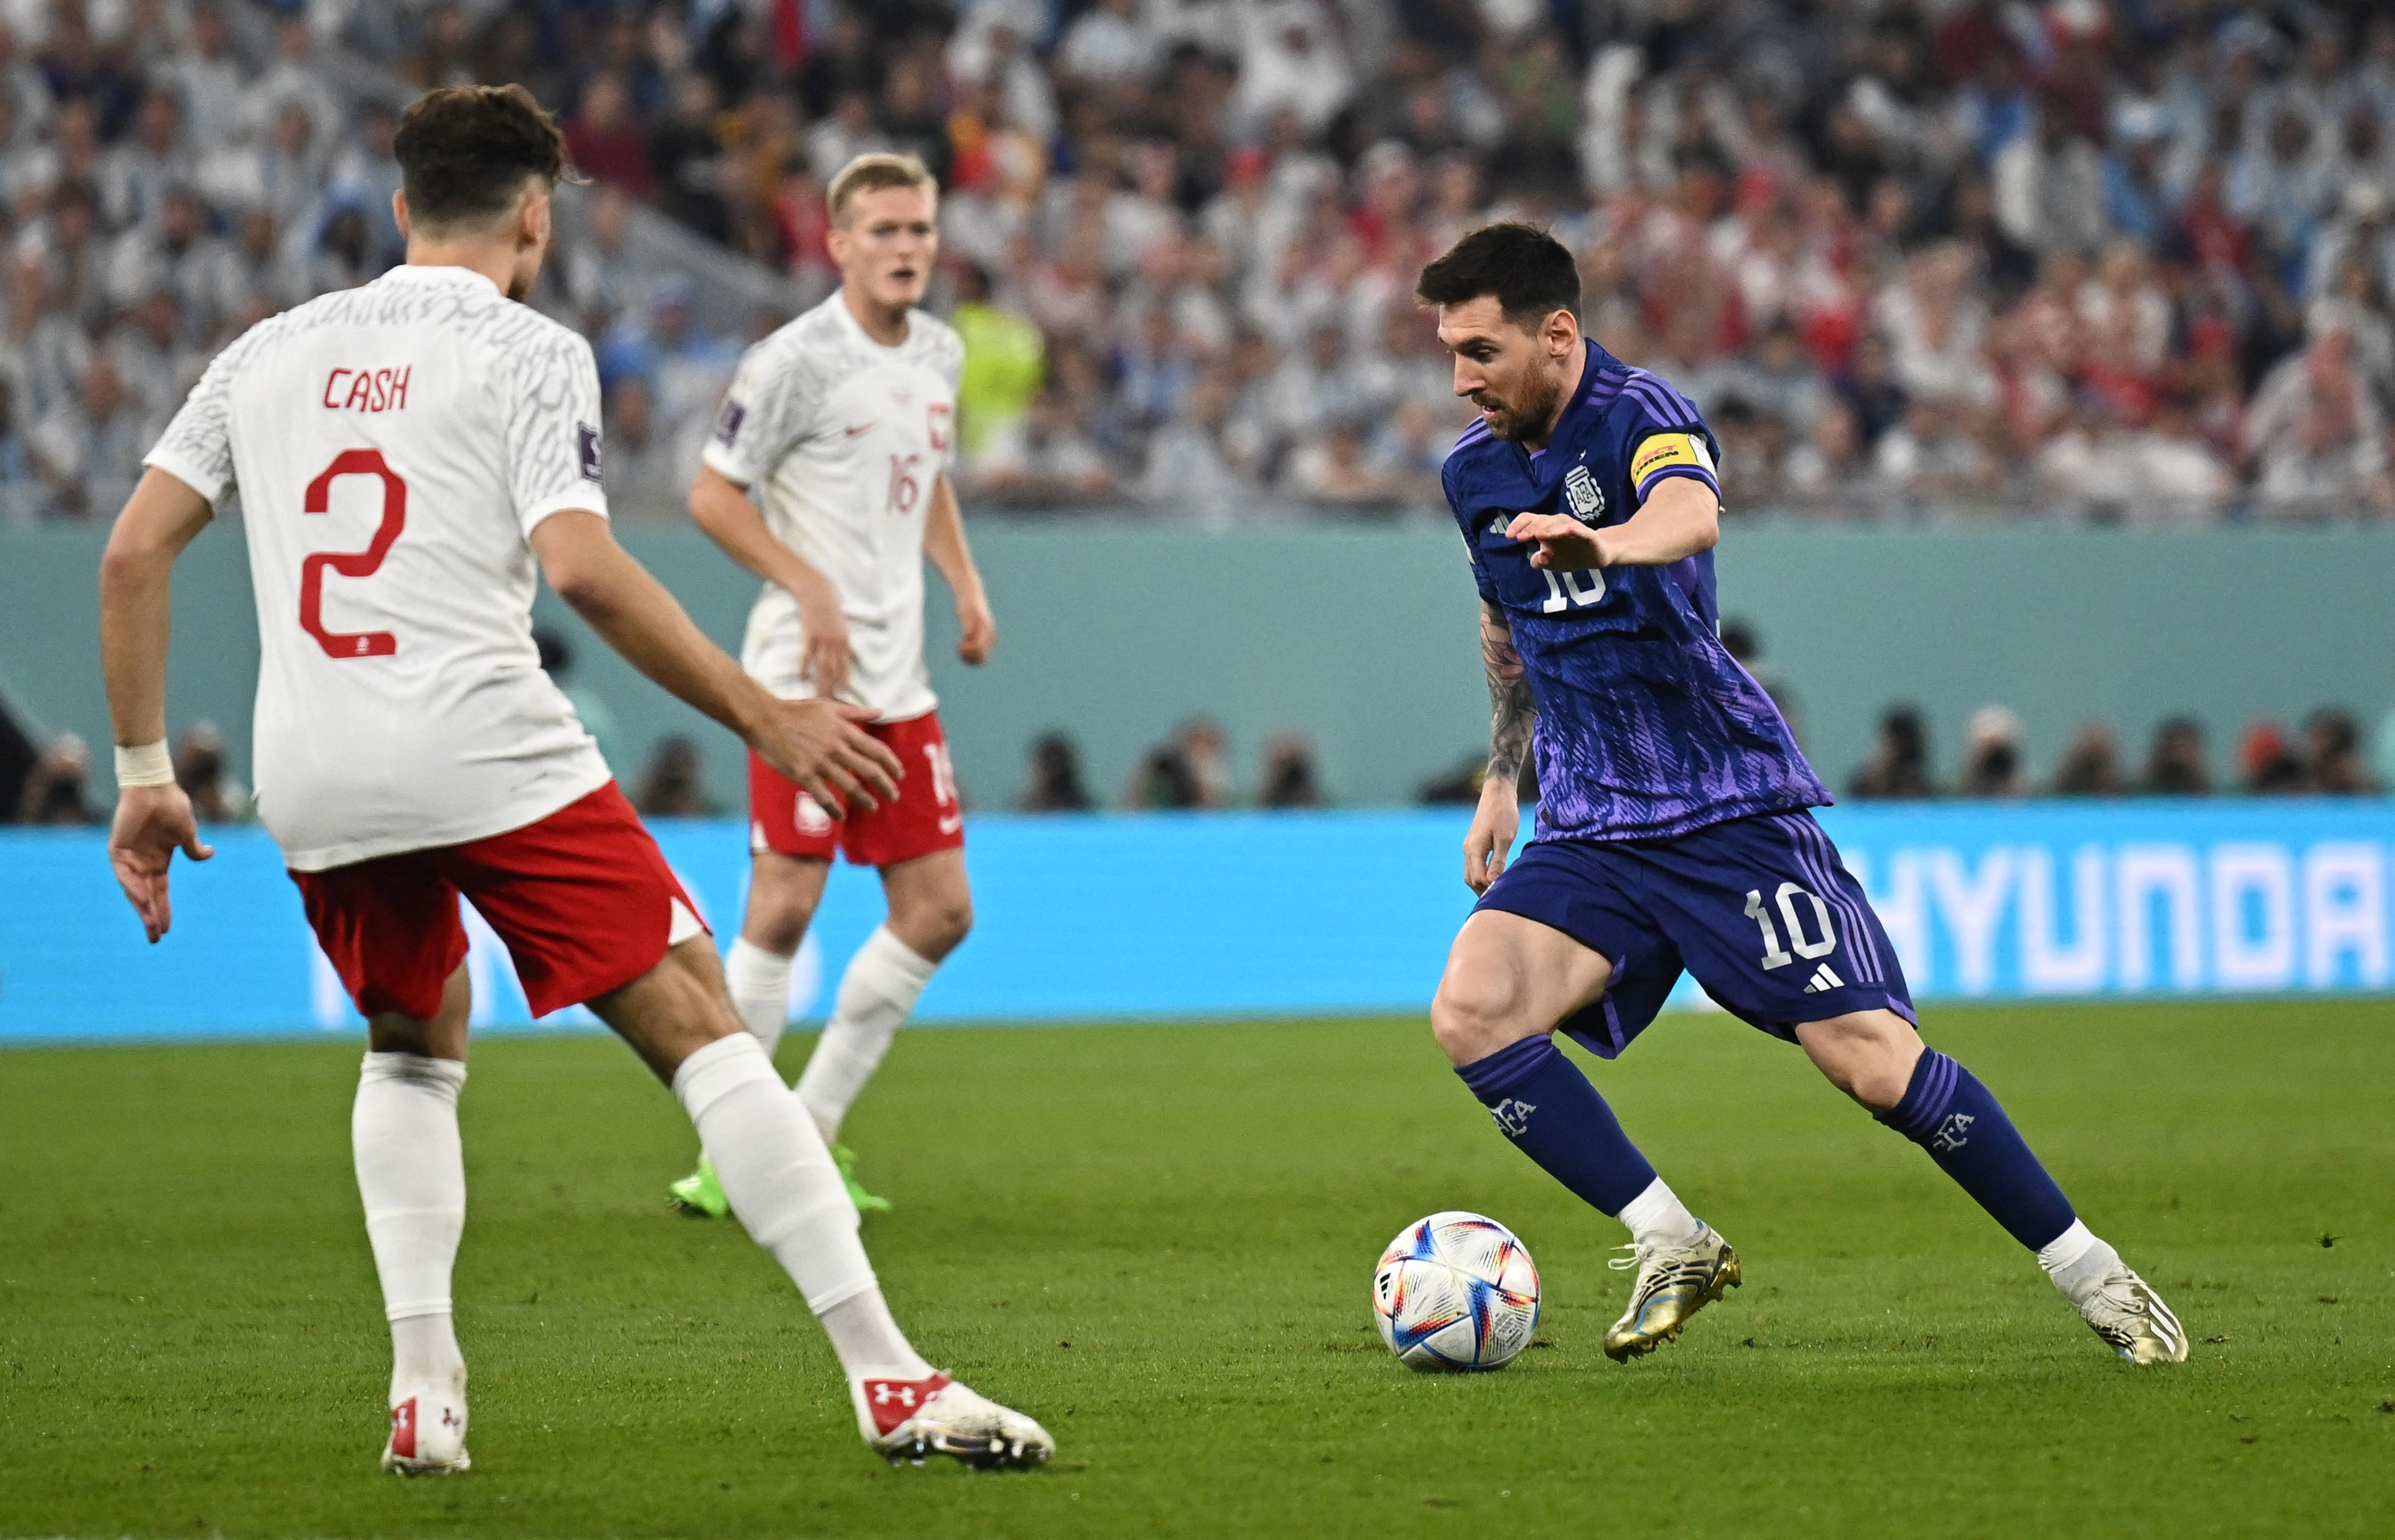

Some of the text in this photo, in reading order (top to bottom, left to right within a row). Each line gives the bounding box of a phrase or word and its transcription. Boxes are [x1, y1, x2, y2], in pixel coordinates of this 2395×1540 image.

[324, 365, 413, 413] CASH
[886, 454, 919, 514] 16
[299, 448, 407, 659] 2
[1744, 881, 1837, 971] 10
